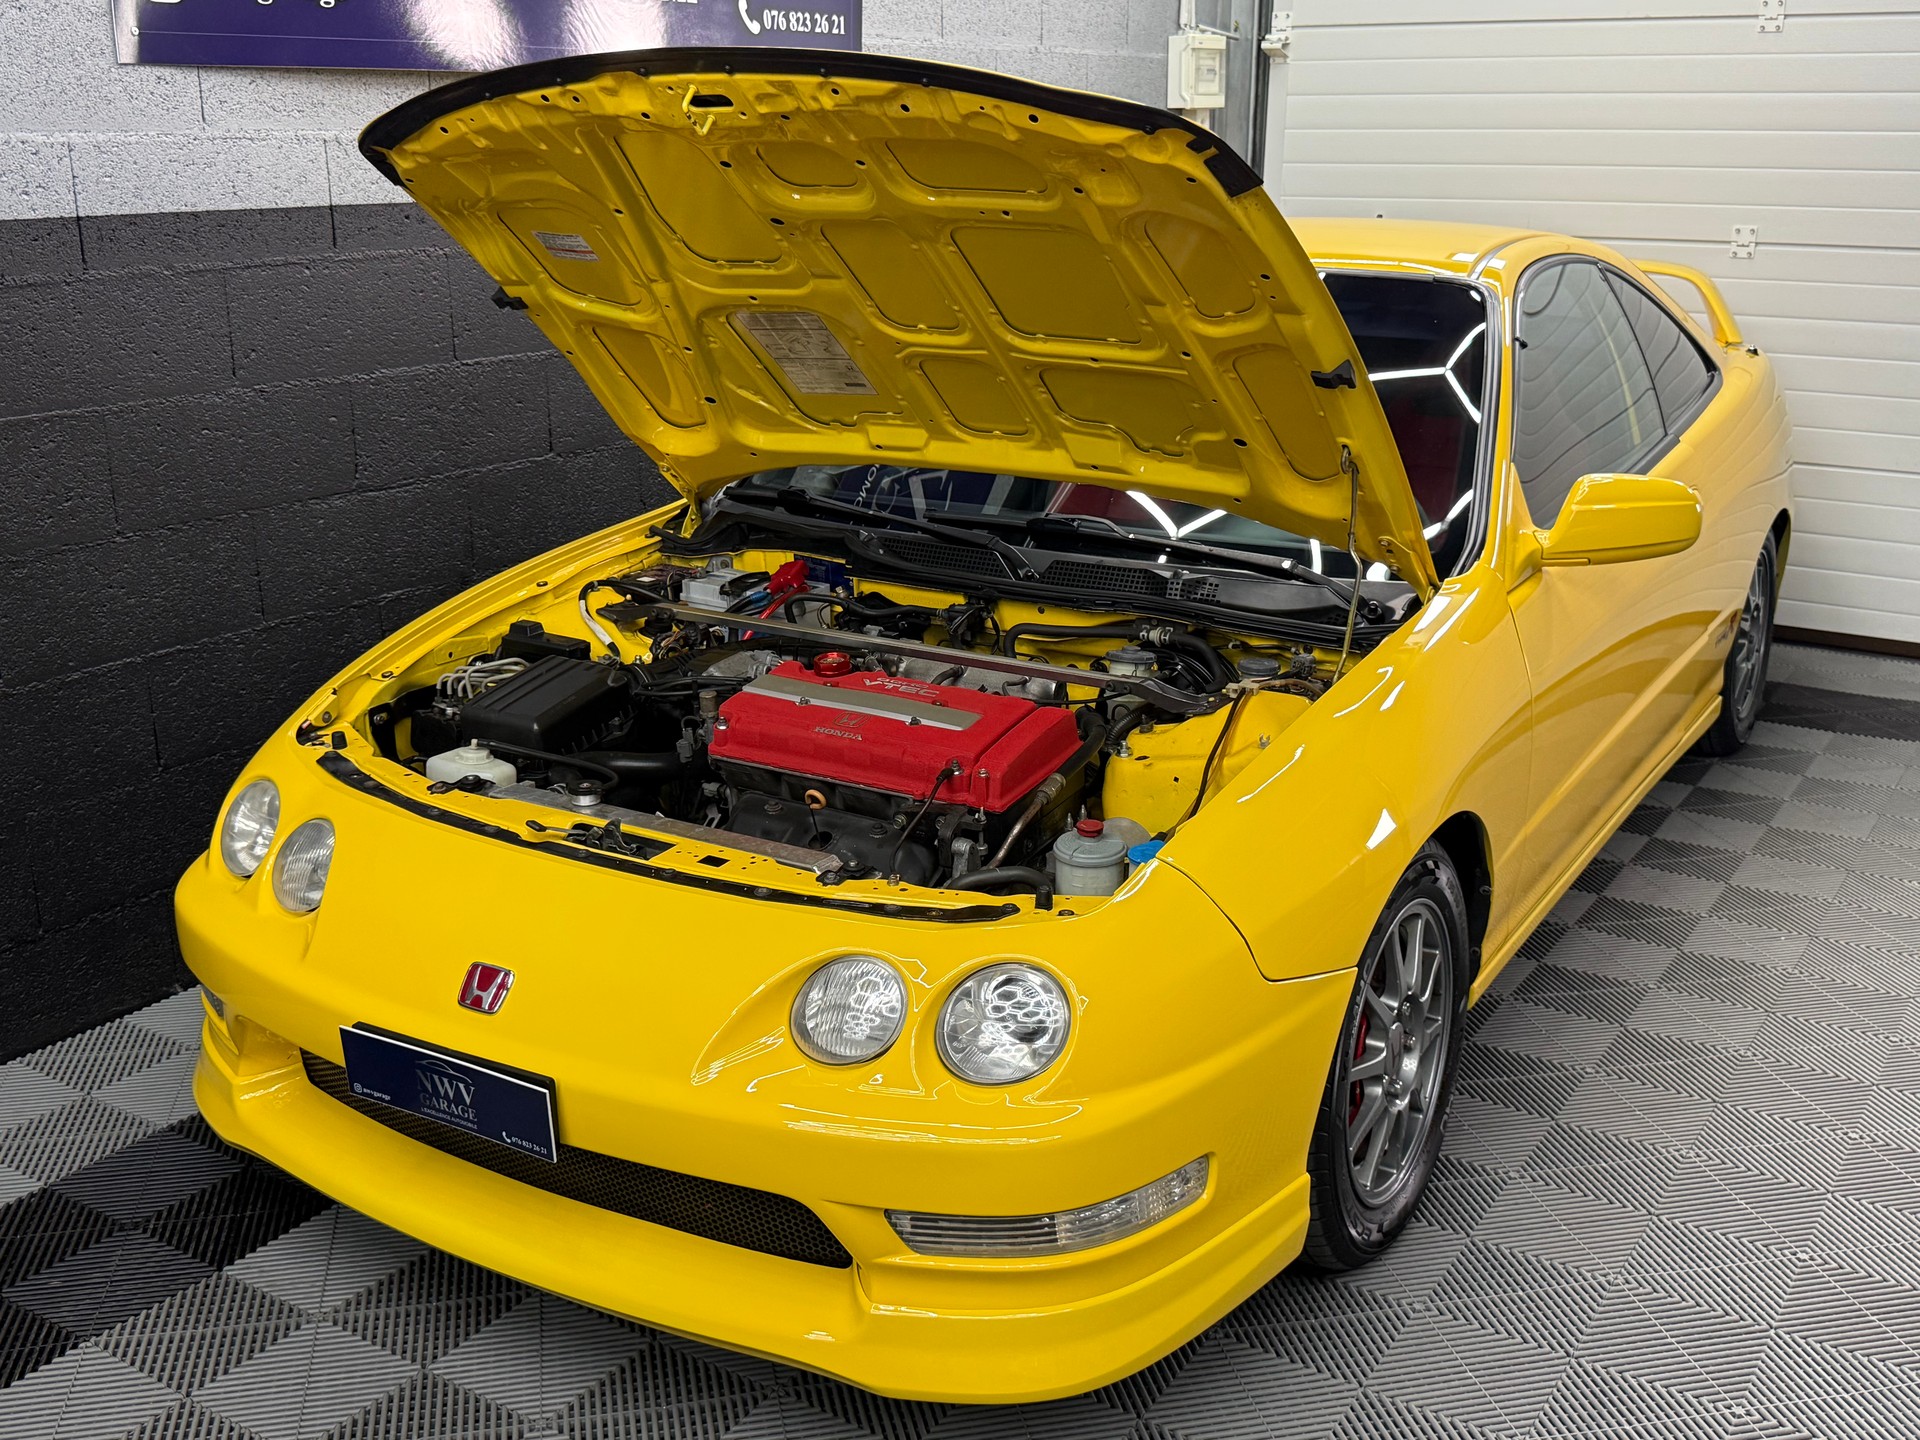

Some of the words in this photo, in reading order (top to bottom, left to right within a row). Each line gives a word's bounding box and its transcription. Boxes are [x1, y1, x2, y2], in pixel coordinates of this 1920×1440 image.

[763, 9, 787, 31] 076
[789, 11, 812, 32] 823
[814, 12, 829, 34] 26
[831, 14, 846, 35] 21
[863, 678, 940, 697] VTEC
[815, 726, 863, 741] HONDA
[415, 1069, 476, 1106] NWV
[420, 1092, 478, 1122] GARAGE
[511, 1136, 522, 1145] 076
[522, 1140, 533, 1149] 823
[533, 1143, 541, 1152] 26
[540, 1146, 547, 1155] 21
